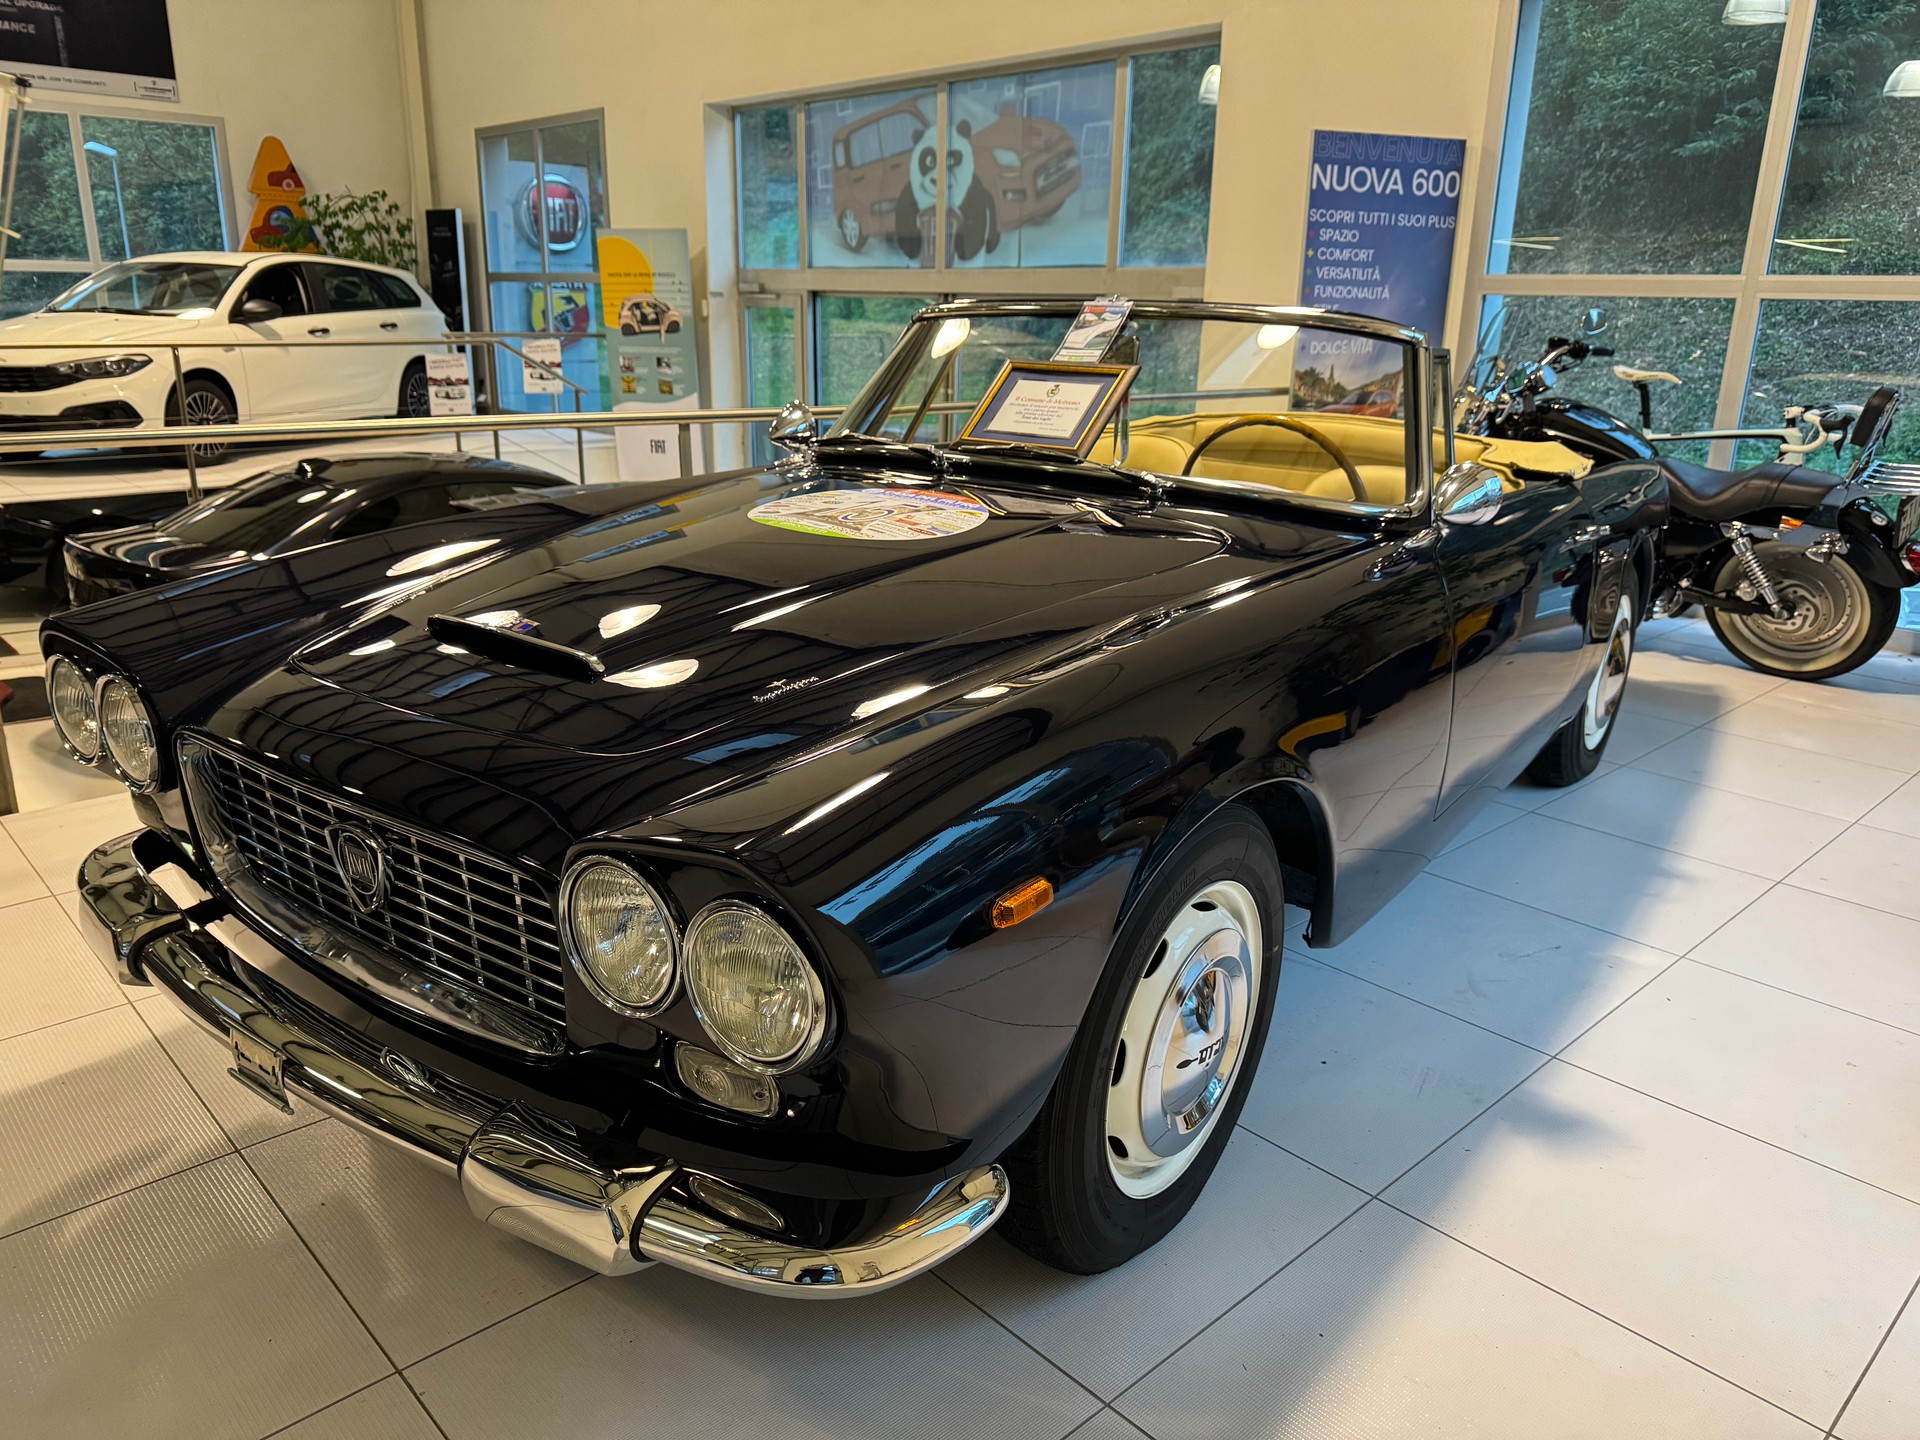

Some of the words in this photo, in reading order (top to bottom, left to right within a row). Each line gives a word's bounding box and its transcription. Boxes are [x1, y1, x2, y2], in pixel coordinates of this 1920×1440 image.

[1314, 131, 1463, 166] BENVENUTA
[1311, 163, 1404, 195] NUOVA
[1412, 168, 1461, 198] 600
[1309, 208, 1355, 224] SCOPRI
[1358, 211, 1389, 226] TUTTI
[1391, 213, 1395, 225] I
[1397, 213, 1426, 228] SUOI
[1428, 214, 1455, 229] PLUS
[1318, 227, 1359, 243] SPAZIO
[1317, 247, 1374, 262] COMFORT
[1315, 264, 1381, 281] VERSATILITÀ
[1313, 283, 1390, 300] FUNZIONALITÀ
[1310, 339, 1348, 355] DOLCE
[1351, 338, 1373, 354] VITA
[1020, 396, 1045, 404] Comune
[650, 439, 666, 455] FIAT
